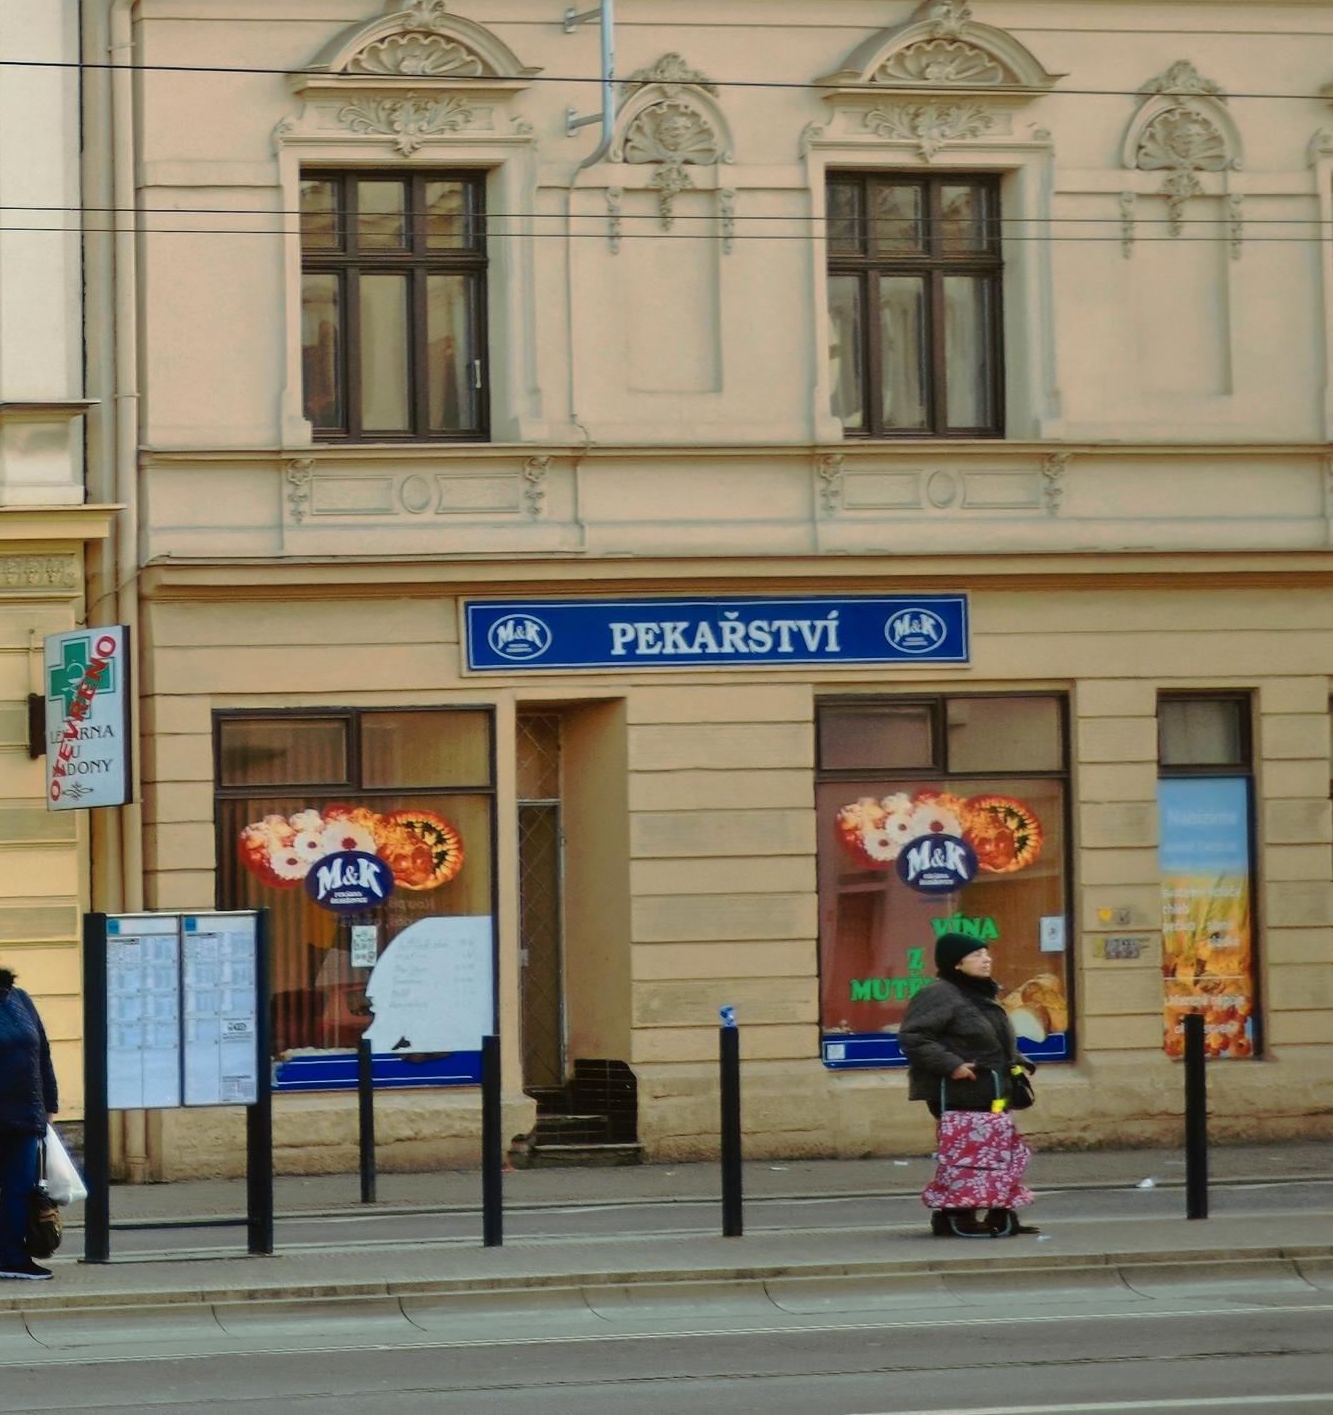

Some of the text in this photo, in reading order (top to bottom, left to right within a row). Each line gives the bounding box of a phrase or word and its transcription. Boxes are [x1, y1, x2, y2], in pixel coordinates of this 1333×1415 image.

[609, 609, 842, 656] PEKAŘSTVÍ
[50, 725, 115, 744] LÉRNA
[53, 759, 115, 777] DONY
[906, 840, 969, 882] M&K
[316, 857, 384, 901] M&K
[931, 911, 1001, 940] VÍNA
[907, 946, 926, 971] Z
